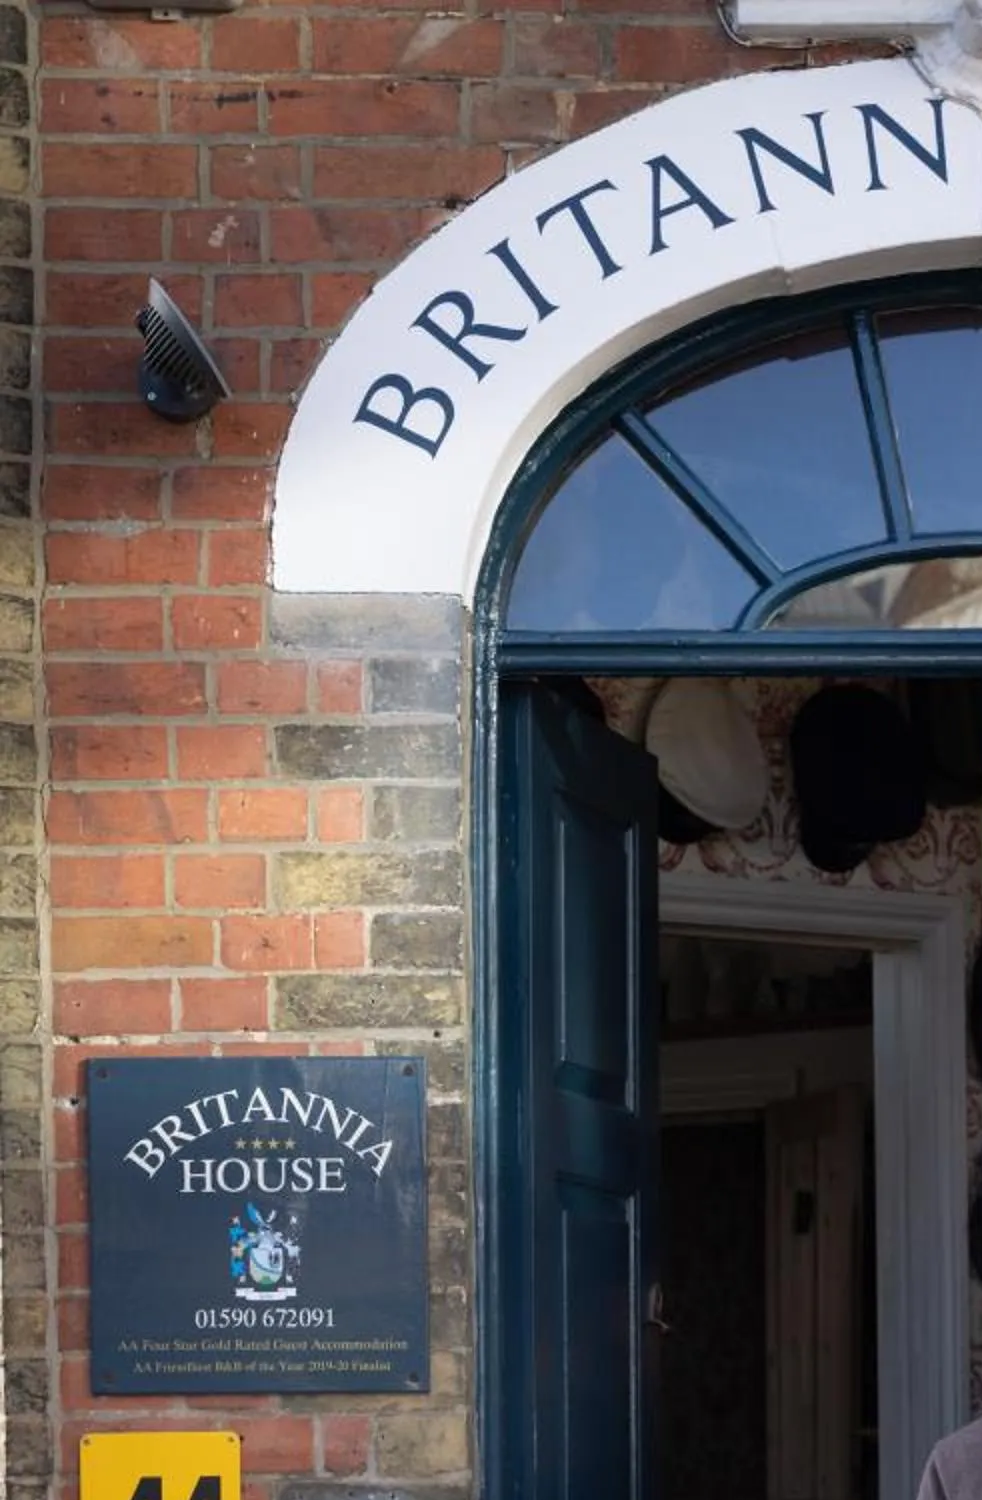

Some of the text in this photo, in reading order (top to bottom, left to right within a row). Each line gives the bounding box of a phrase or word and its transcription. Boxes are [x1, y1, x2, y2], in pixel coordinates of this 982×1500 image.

[124, 1086, 394, 1179] BRITANNIA
[179, 1157, 347, 1194] HOUSE
[195, 1308, 335, 1329] 01590 672091
[201, 1338, 231, 1352] Gold
[235, 1338, 270, 1352] Rated
